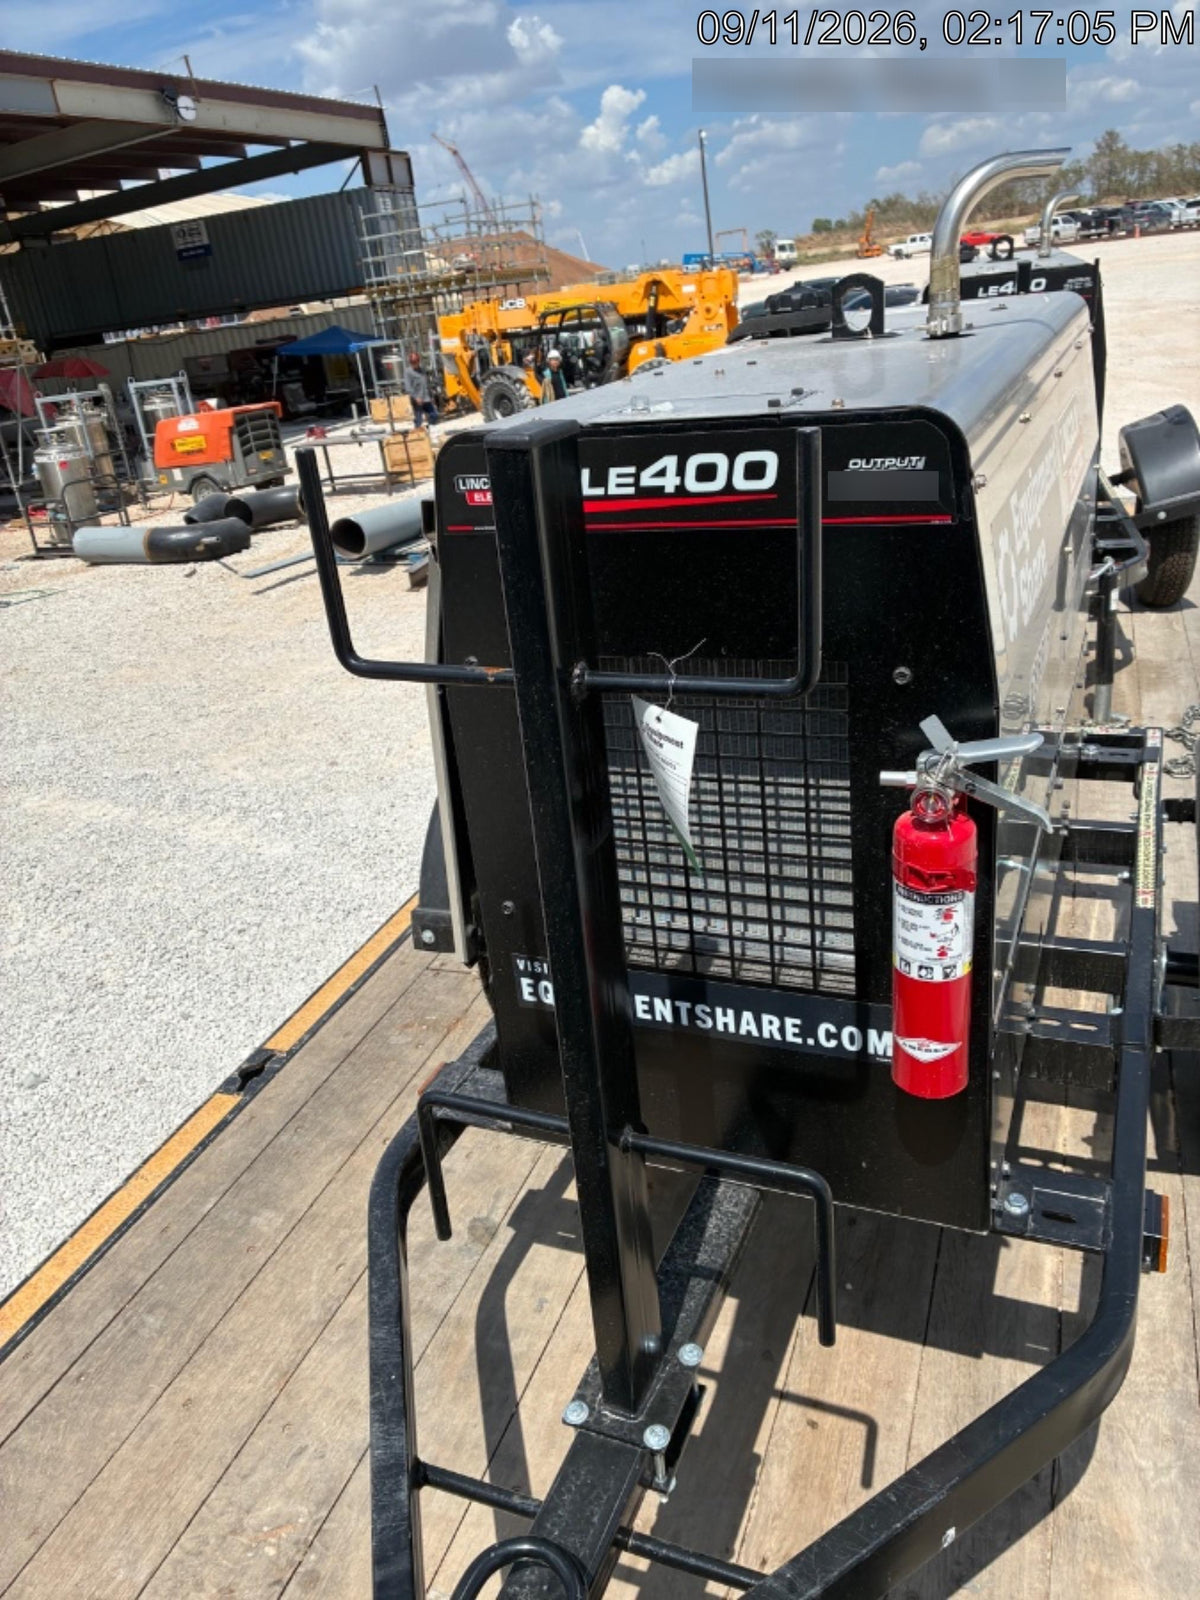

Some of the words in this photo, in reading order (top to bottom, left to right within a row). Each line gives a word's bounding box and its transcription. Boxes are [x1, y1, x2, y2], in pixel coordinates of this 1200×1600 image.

[977, 277, 1047, 298] LE40
[582, 450, 779, 496] LE400
[516, 959, 549, 975] VISI
